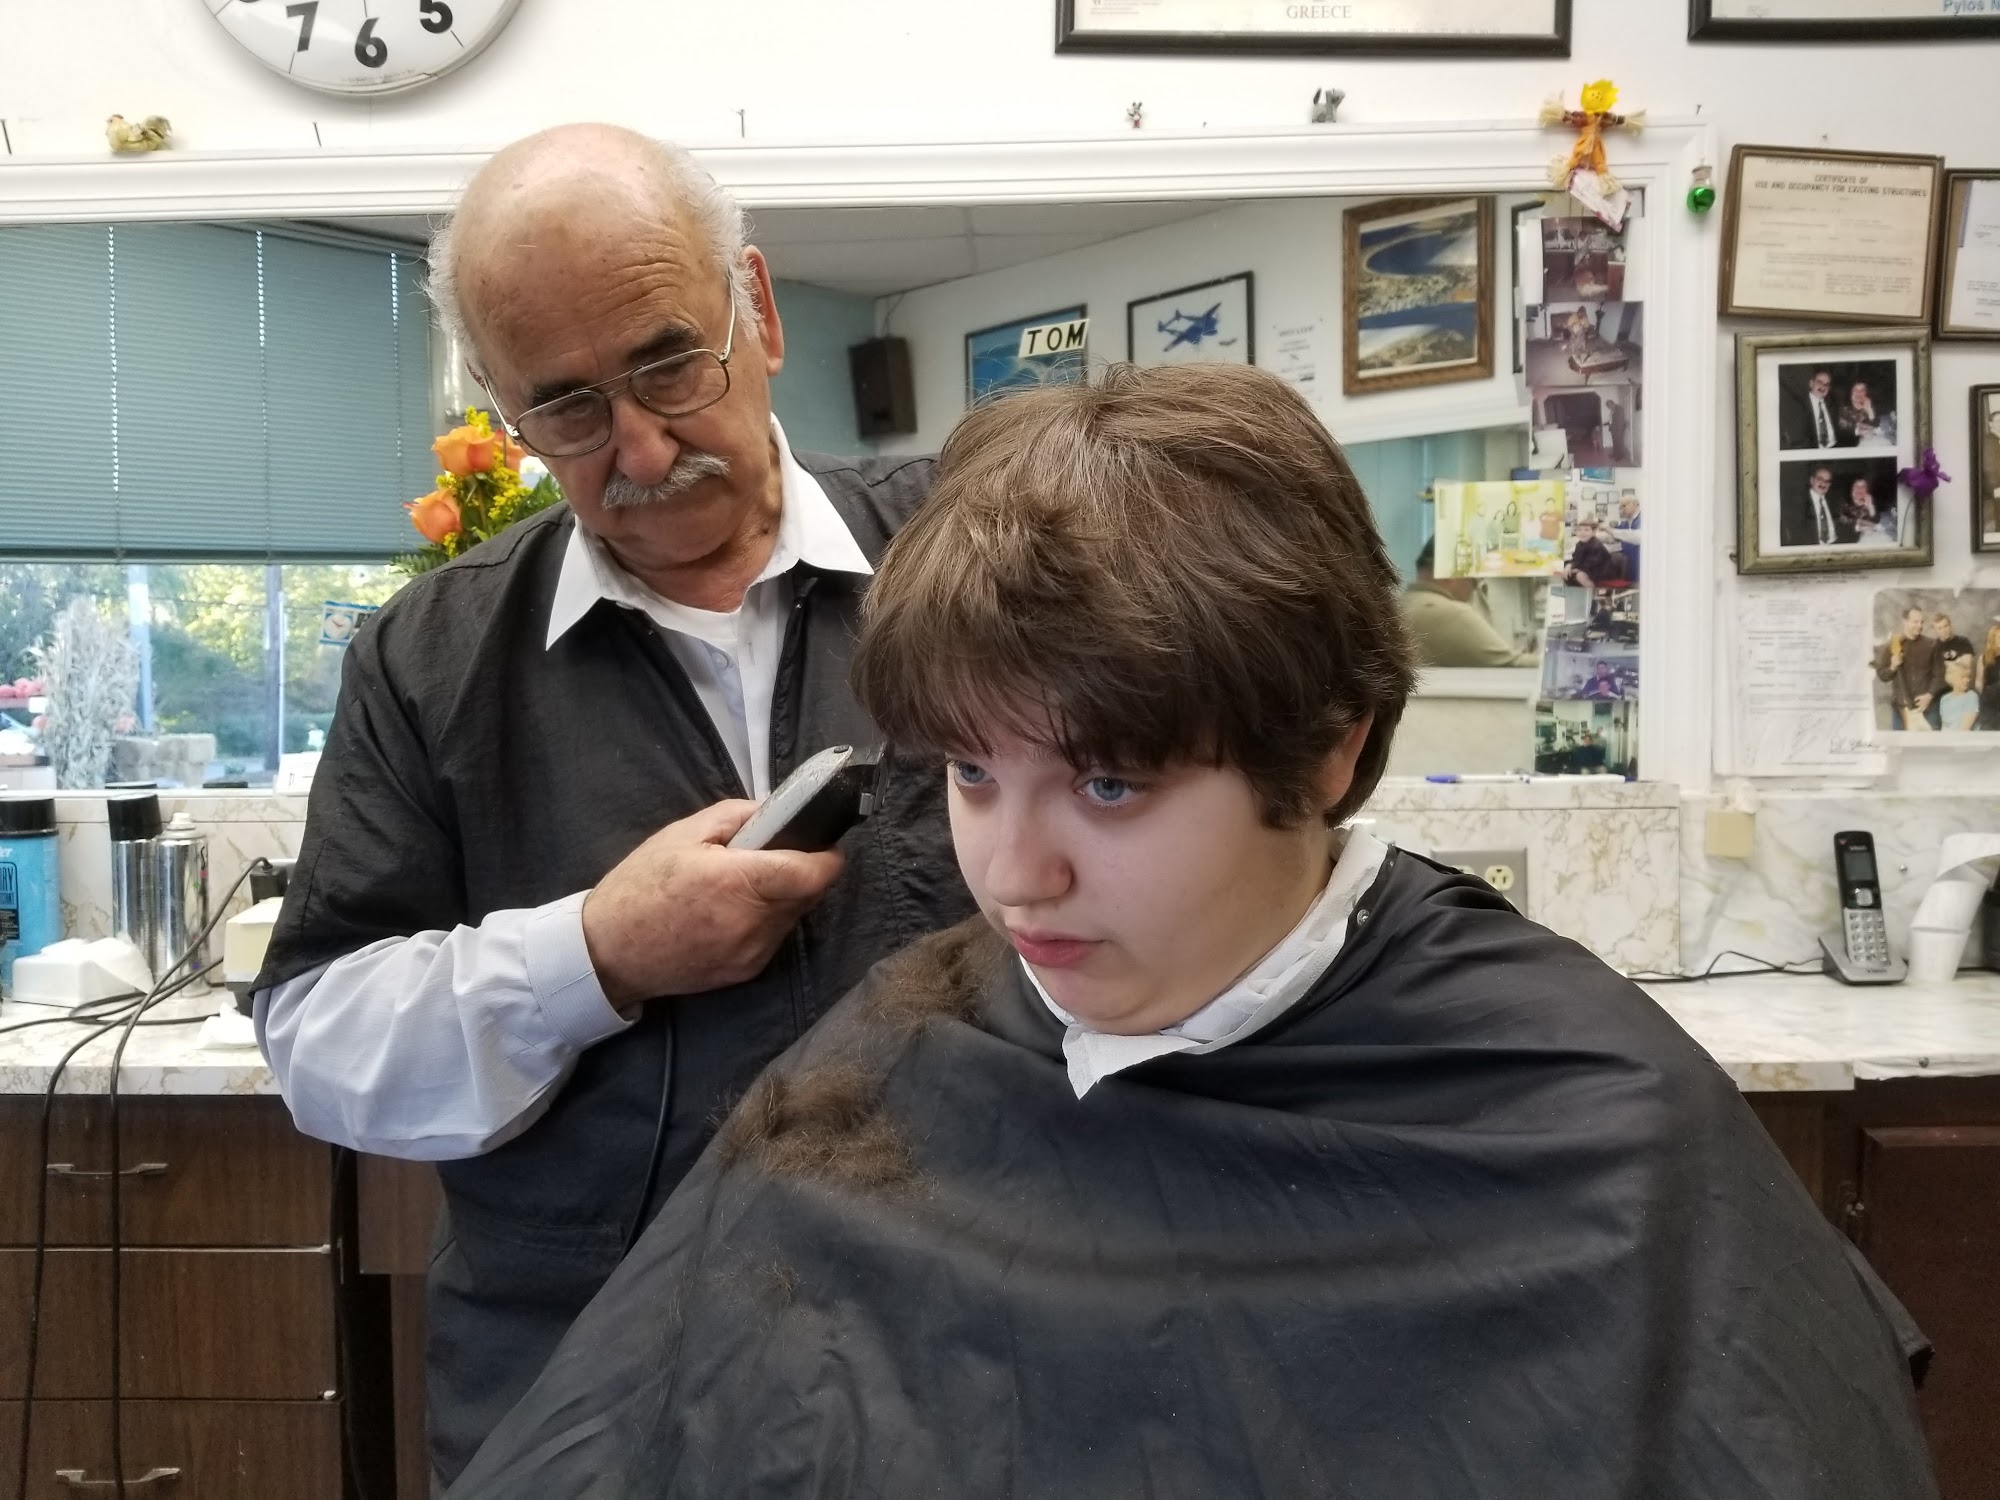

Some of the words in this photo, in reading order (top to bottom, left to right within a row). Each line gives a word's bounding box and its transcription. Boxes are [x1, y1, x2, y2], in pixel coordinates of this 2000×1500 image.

[420, 0, 453, 34] 5
[1286, 5, 1352, 19] GREECE
[1943, 0, 1985, 16] Pylos
[286, 1, 319, 52] 7
[354, 17, 388, 68] 6
[1755, 181, 1769, 189] USE
[1771, 182, 1786, 190] AND
[1788, 182, 1830, 193] OCCUPANCY
[1832, 184, 1844, 193] FOR
[1847, 185, 1879, 195] EXISTING
[1882, 187, 1928, 197] STRUCTURES
[1814, 174, 1857, 185] CERTIFICATE
[1859, 176, 1869, 184] OF
[1027, 321, 1086, 354] TOM
